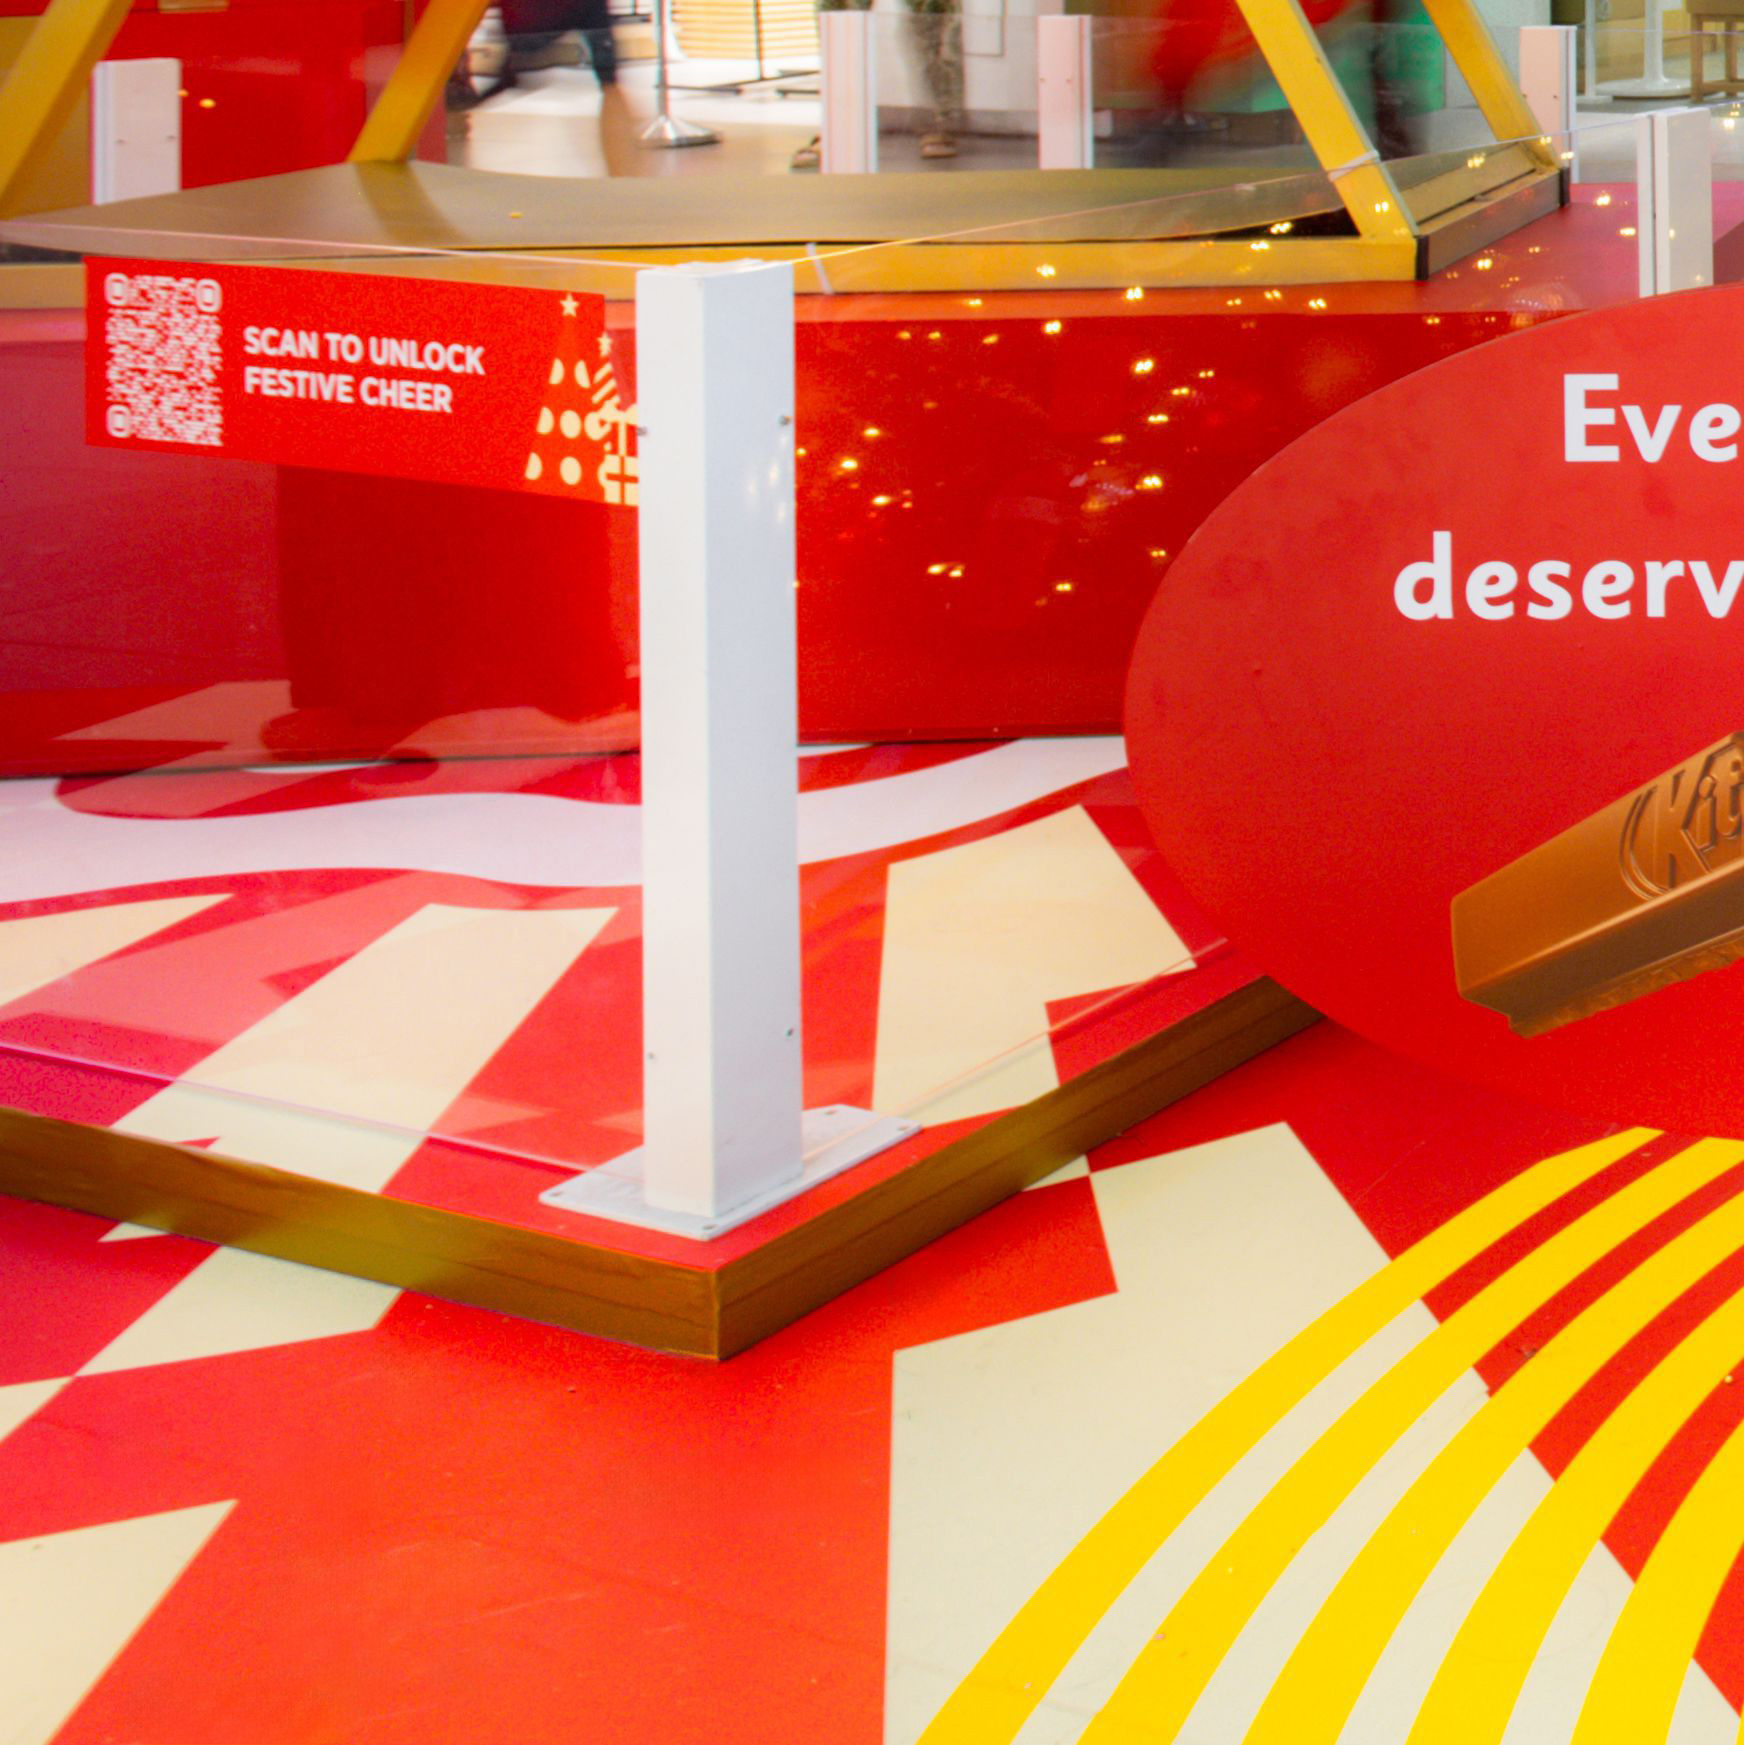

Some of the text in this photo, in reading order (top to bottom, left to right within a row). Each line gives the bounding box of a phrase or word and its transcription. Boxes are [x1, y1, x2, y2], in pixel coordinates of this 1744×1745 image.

[242, 326, 486, 376] SCAN TO UNLOCK
[243, 366, 454, 414] FESTIVE CHEER
